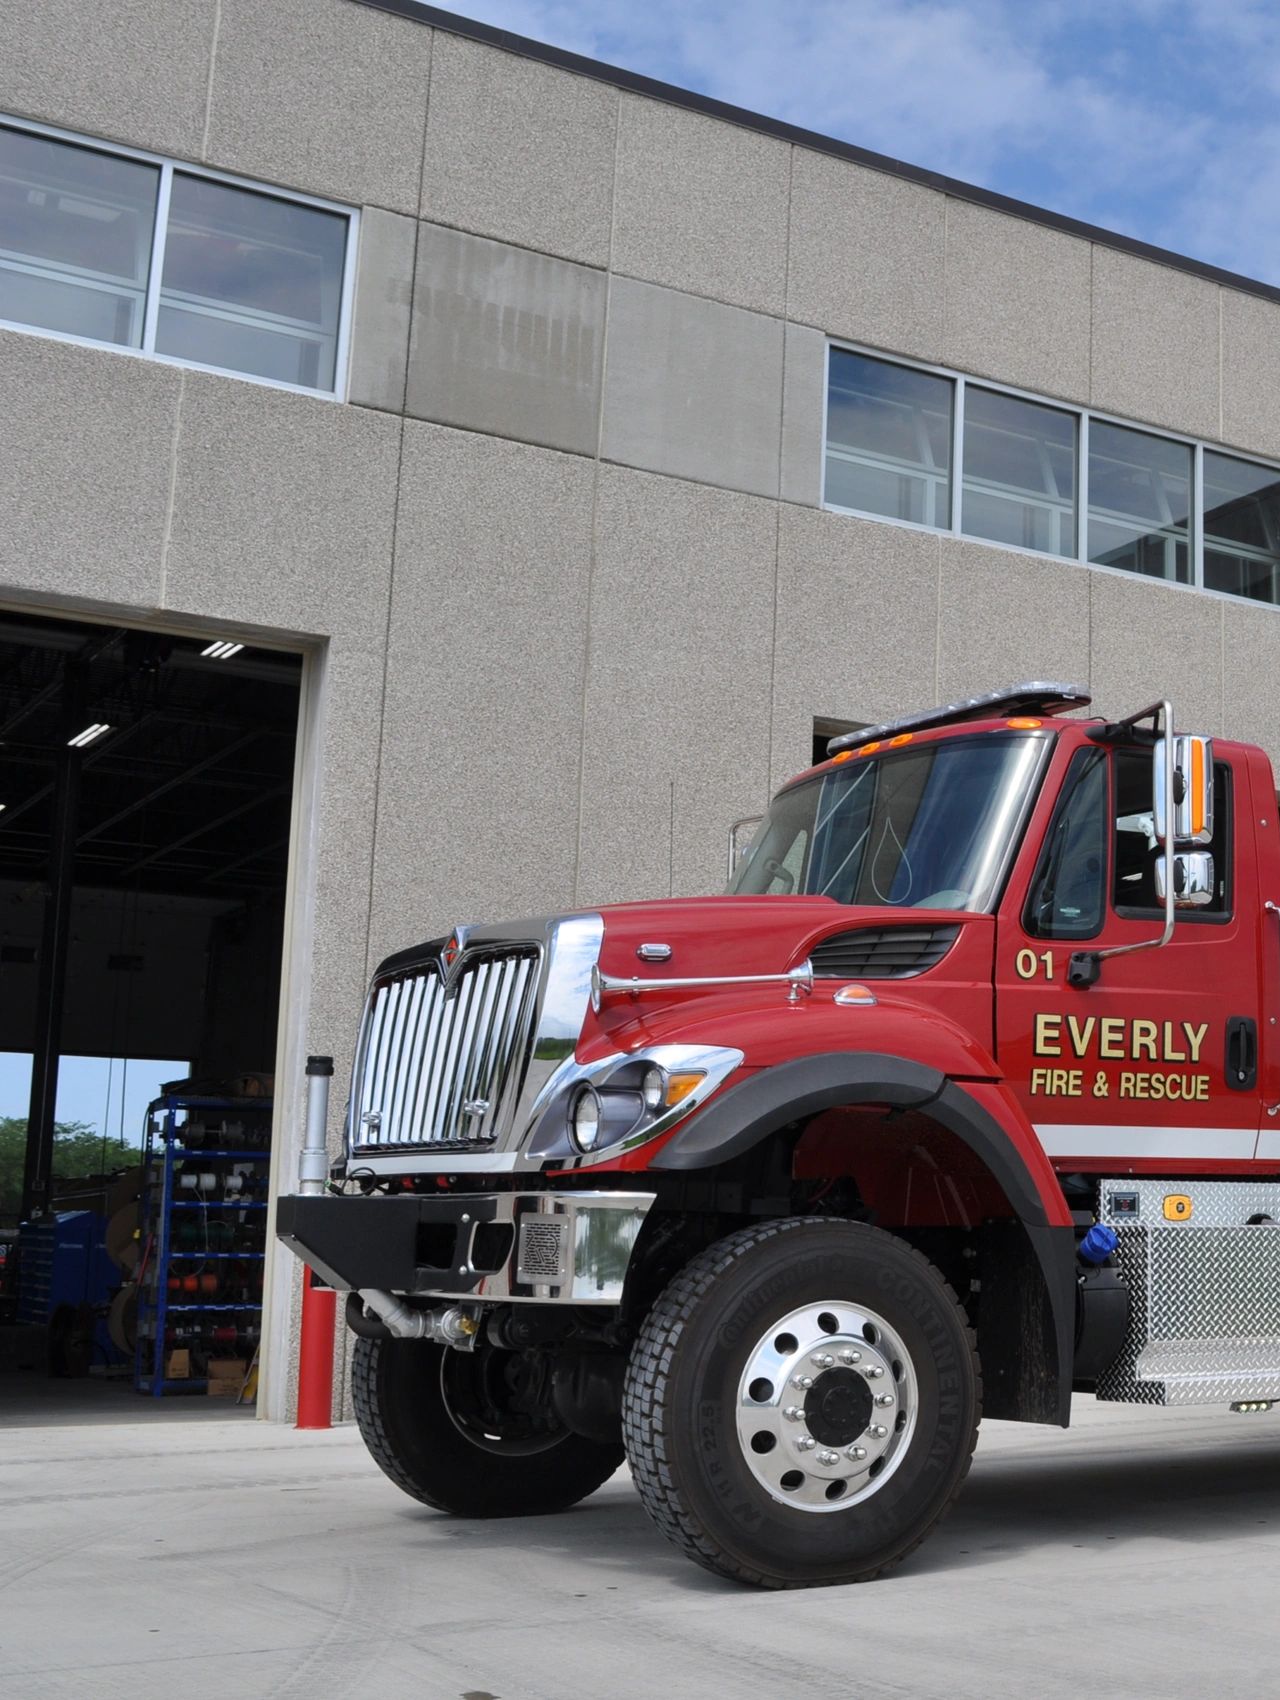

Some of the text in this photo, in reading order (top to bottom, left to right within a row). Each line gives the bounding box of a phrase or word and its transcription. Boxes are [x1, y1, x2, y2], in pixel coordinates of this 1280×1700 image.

[1015, 948, 1054, 979] 01
[1034, 1014, 1209, 1062] EVERLY
[1031, 1068, 1210, 1100] FIRE & RESCUE
[876, 1265, 960, 1471] CONTINENTAL
